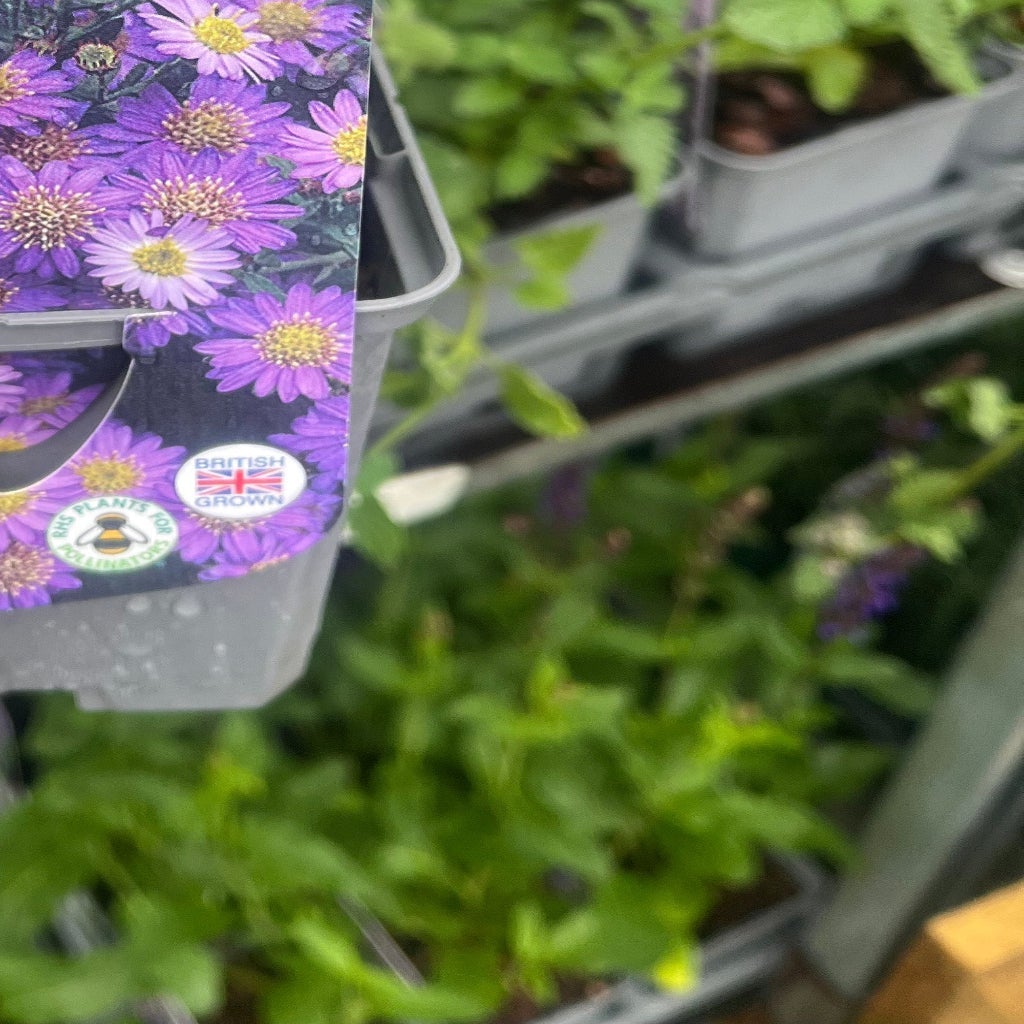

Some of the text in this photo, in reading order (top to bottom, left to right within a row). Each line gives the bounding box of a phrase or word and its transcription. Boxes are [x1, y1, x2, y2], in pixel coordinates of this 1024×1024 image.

[194, 455, 286, 470] BRITISH
[194, 494, 286, 509] GROWN
[52, 496, 173, 540] RHS PLANTS FOR
[59, 538, 170, 570] POLLINATORS
